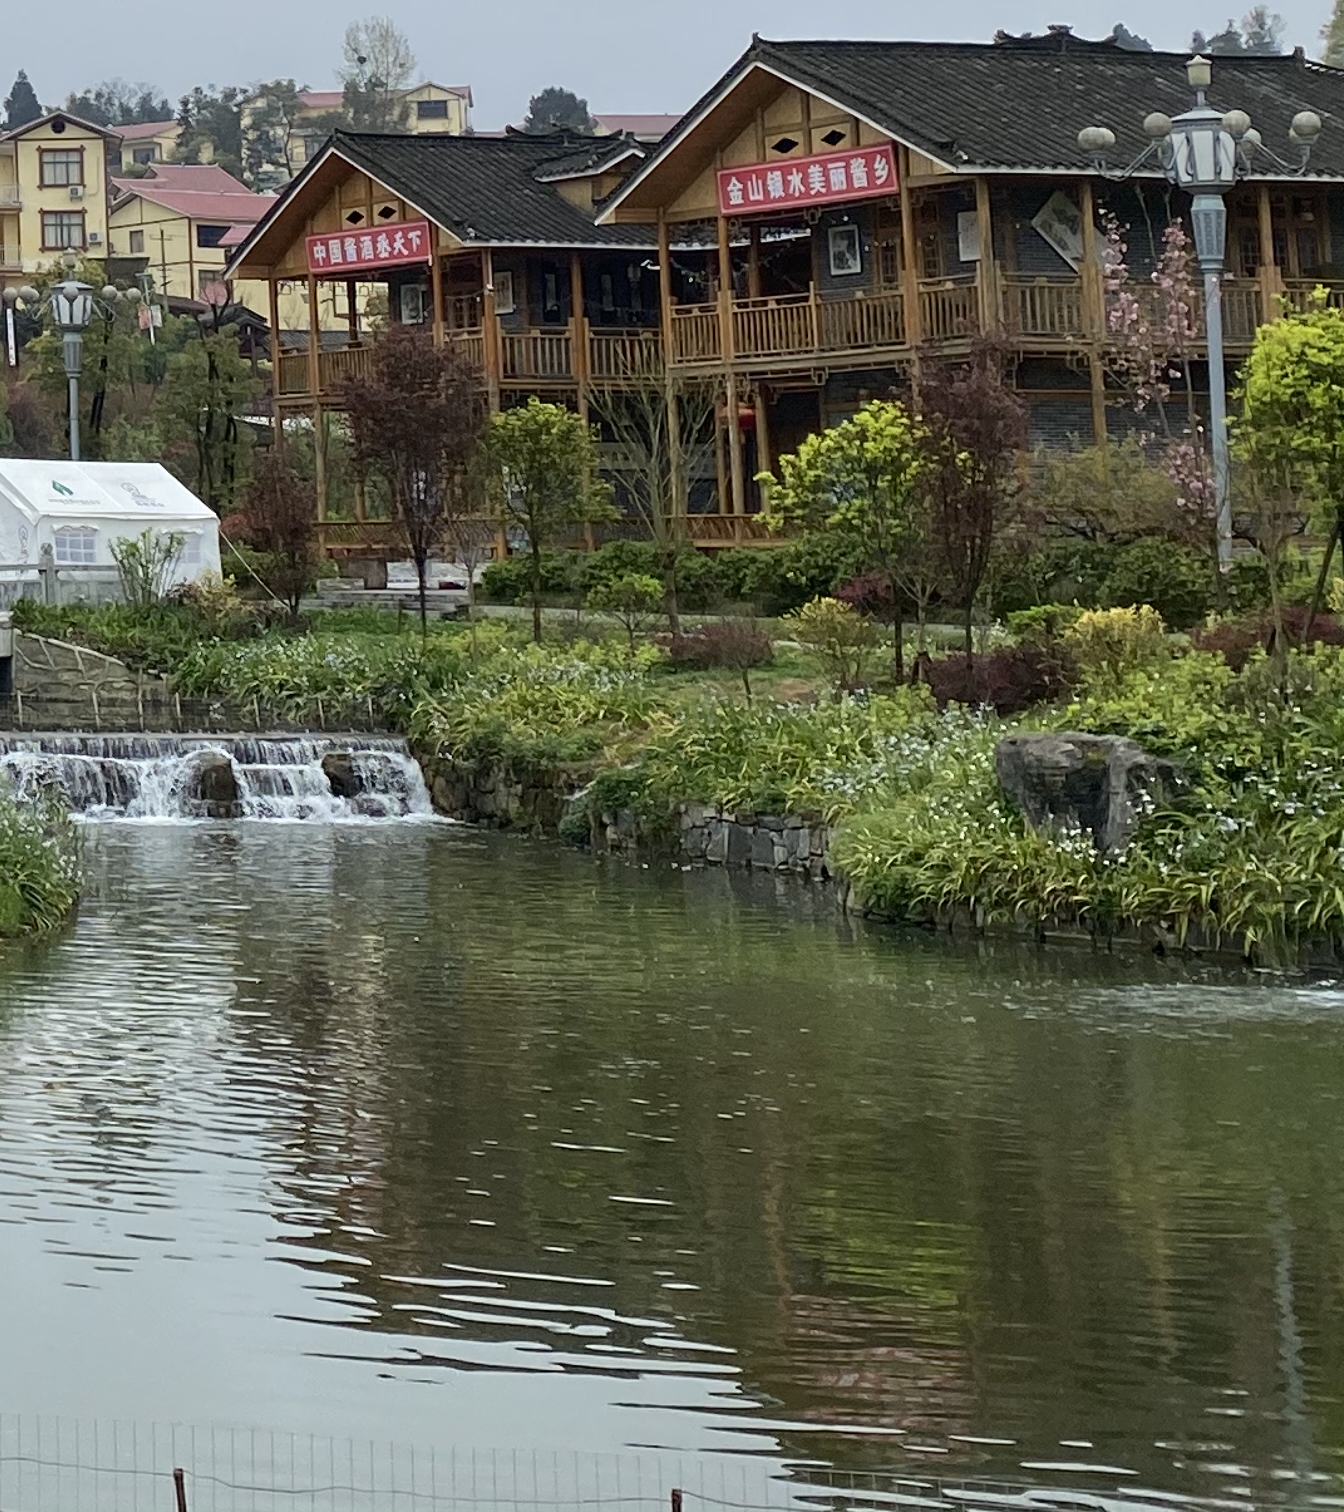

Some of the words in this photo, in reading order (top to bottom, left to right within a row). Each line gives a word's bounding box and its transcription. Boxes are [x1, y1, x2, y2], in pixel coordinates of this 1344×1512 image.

[727, 153, 889, 205] 金山银水美丽酱乡
